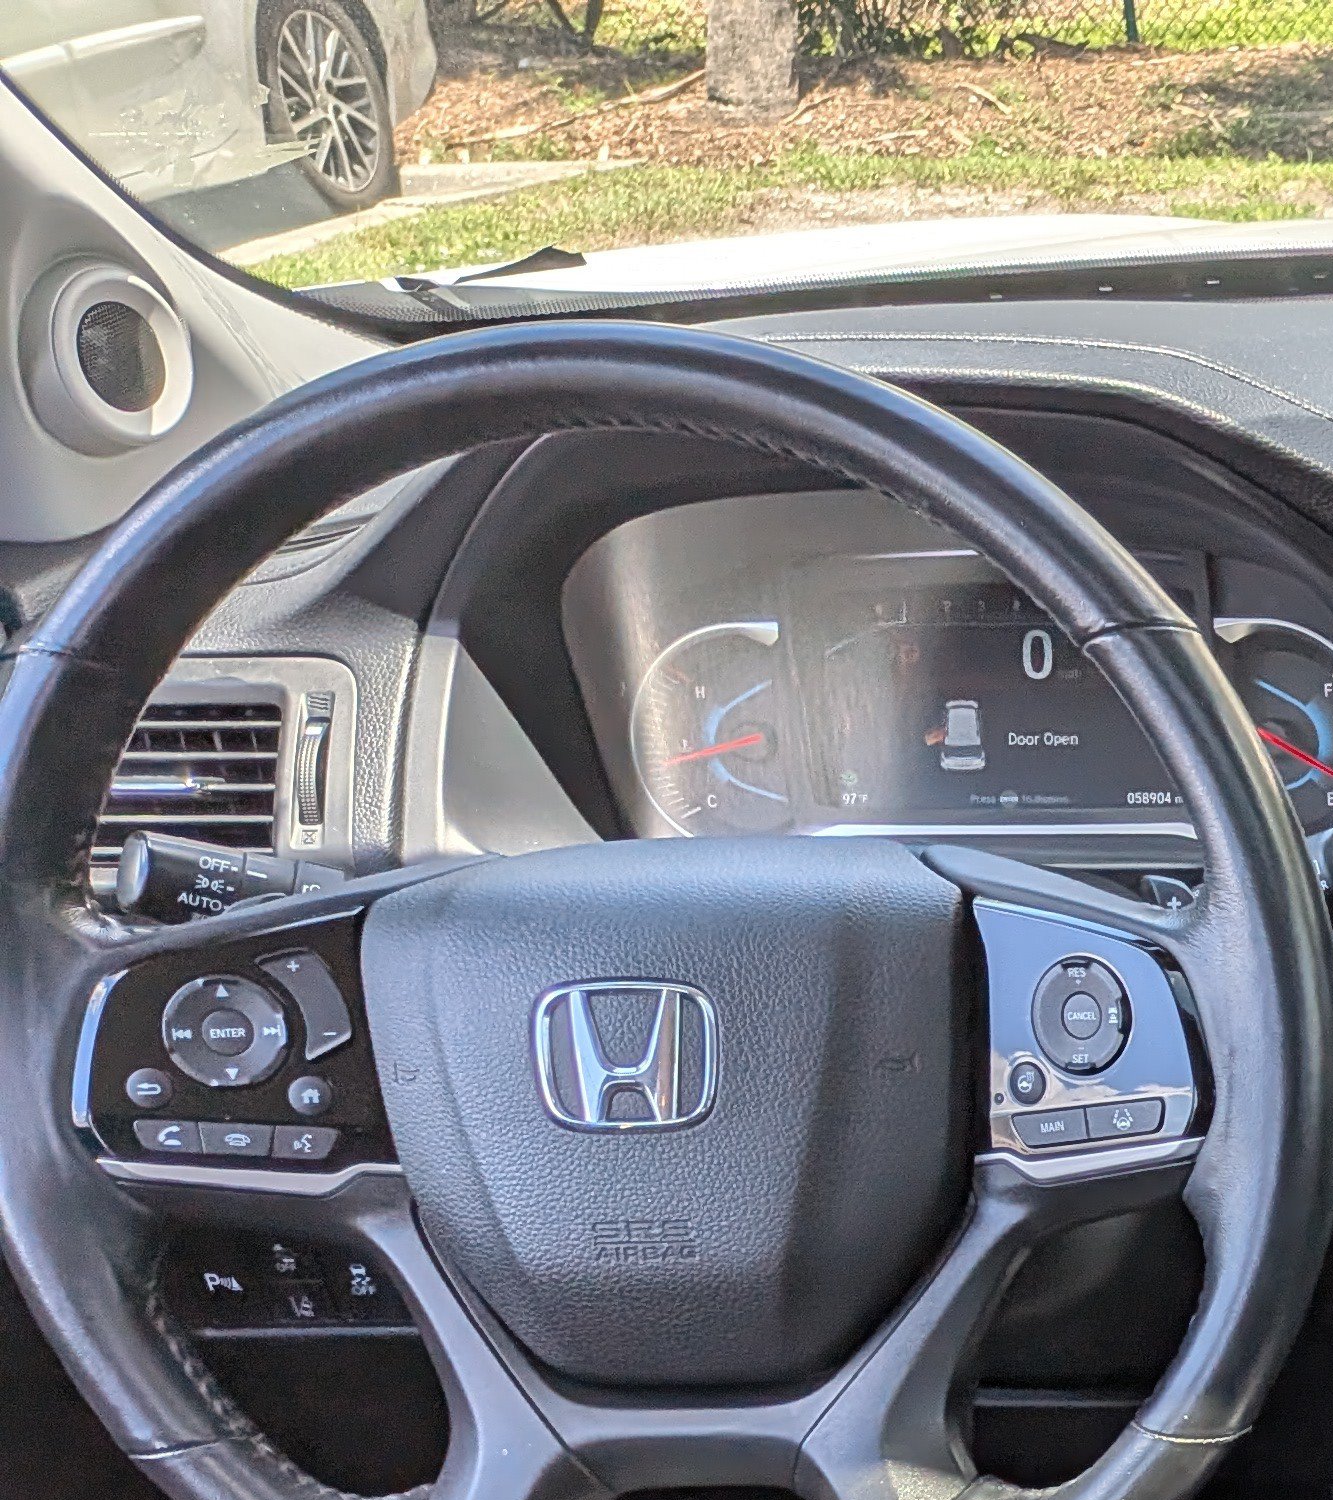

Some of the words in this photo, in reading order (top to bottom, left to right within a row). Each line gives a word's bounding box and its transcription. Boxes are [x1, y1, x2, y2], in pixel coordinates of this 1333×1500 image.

[1023, 629, 1053, 680] 0
[695, 686, 705, 698] H
[1323, 683, 1333, 697] F
[1008, 732, 1039, 745] Door
[1044, 732, 1079, 747] Open
[707, 795, 717, 808] C
[1127, 792, 1172, 805] 058904
[199, 856, 230, 872] OFF
[177, 892, 222, 911] AUTO
[1068, 967, 1086, 978] RES
[1068, 1011, 1096, 1021] CANCEL
[210, 1027, 245, 1039] ENTER
[1072, 1054, 1089, 1063] SET
[1040, 1120, 1064, 1132] MAIN
